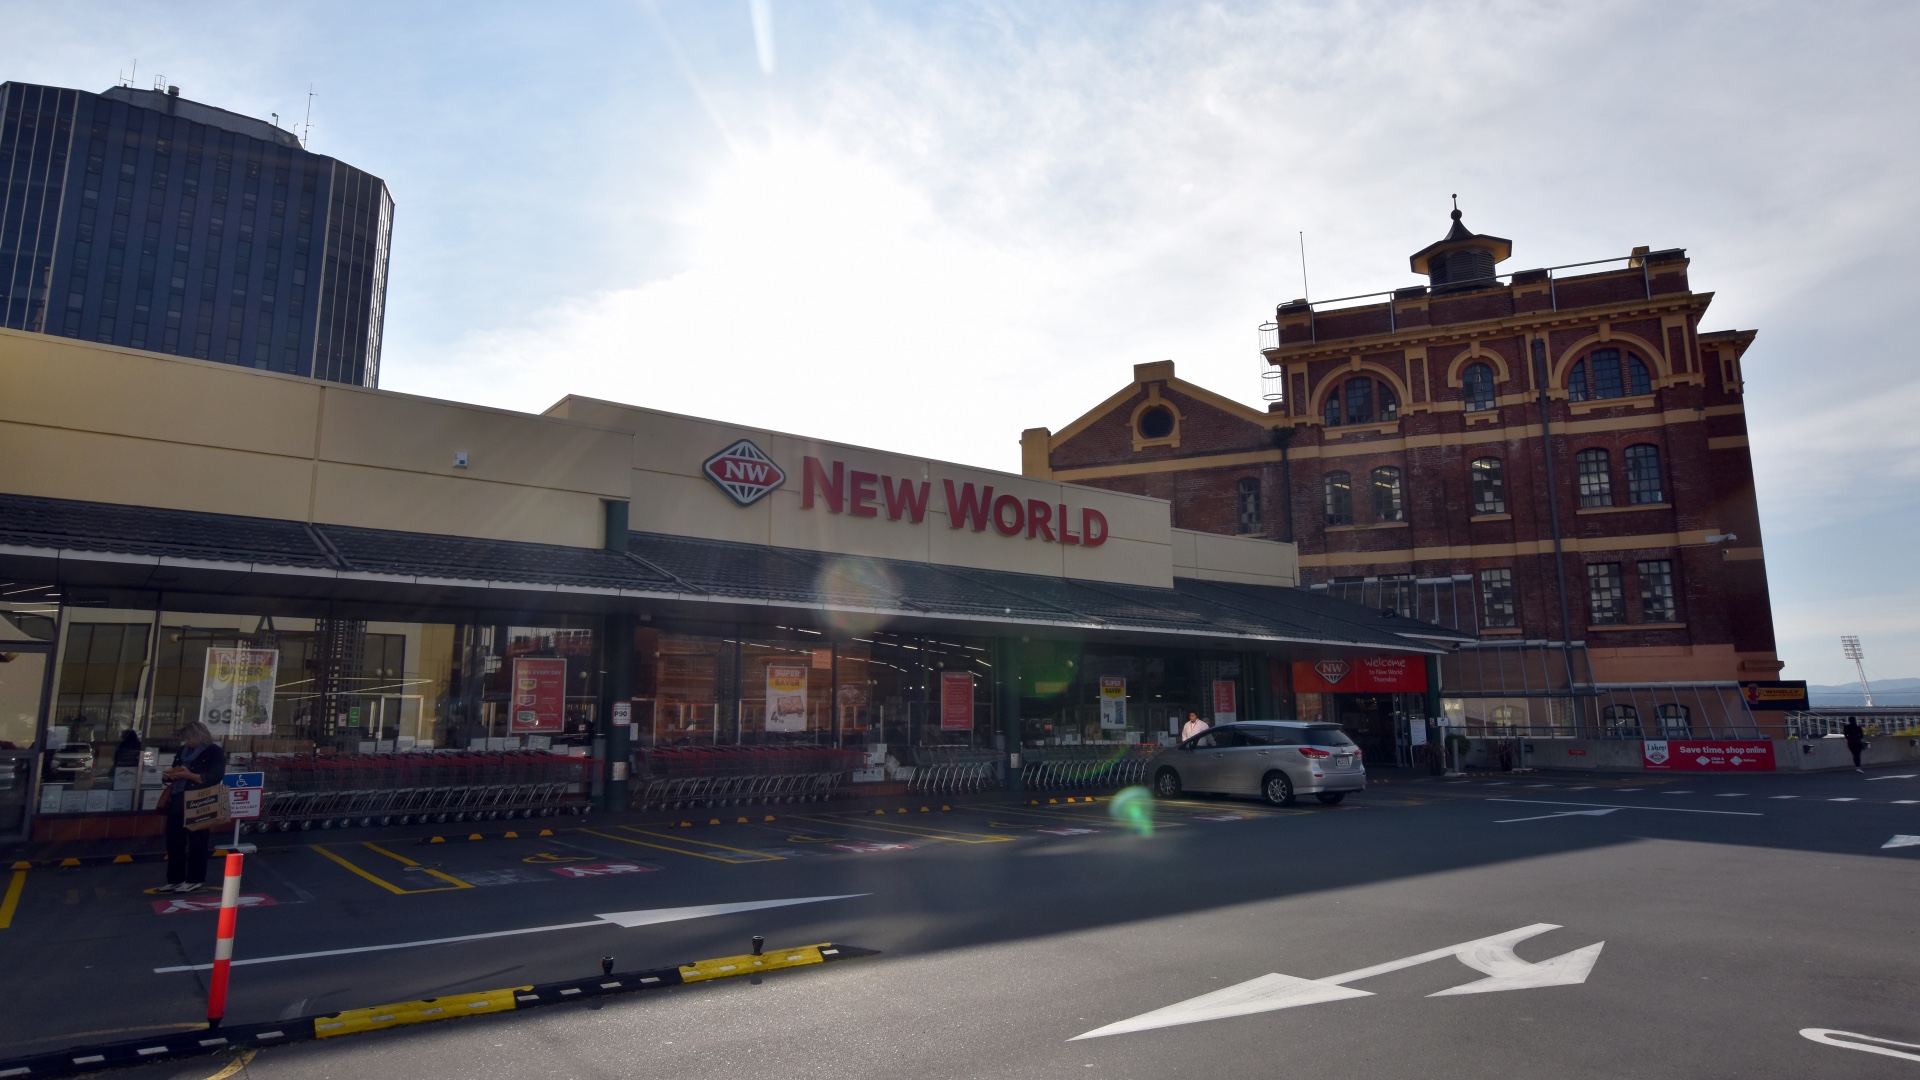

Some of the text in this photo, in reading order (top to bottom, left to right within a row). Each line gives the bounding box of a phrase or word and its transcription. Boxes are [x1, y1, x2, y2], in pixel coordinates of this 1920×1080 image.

[724, 459, 769, 483] NW
[1364, 657, 1406, 667] Welcome
[1322, 663, 1343, 673] NW
[774, 669, 801, 677] SUPER
[775, 679, 800, 687] SAVER
[1679, 746, 1767, 755] Save time, shop online
